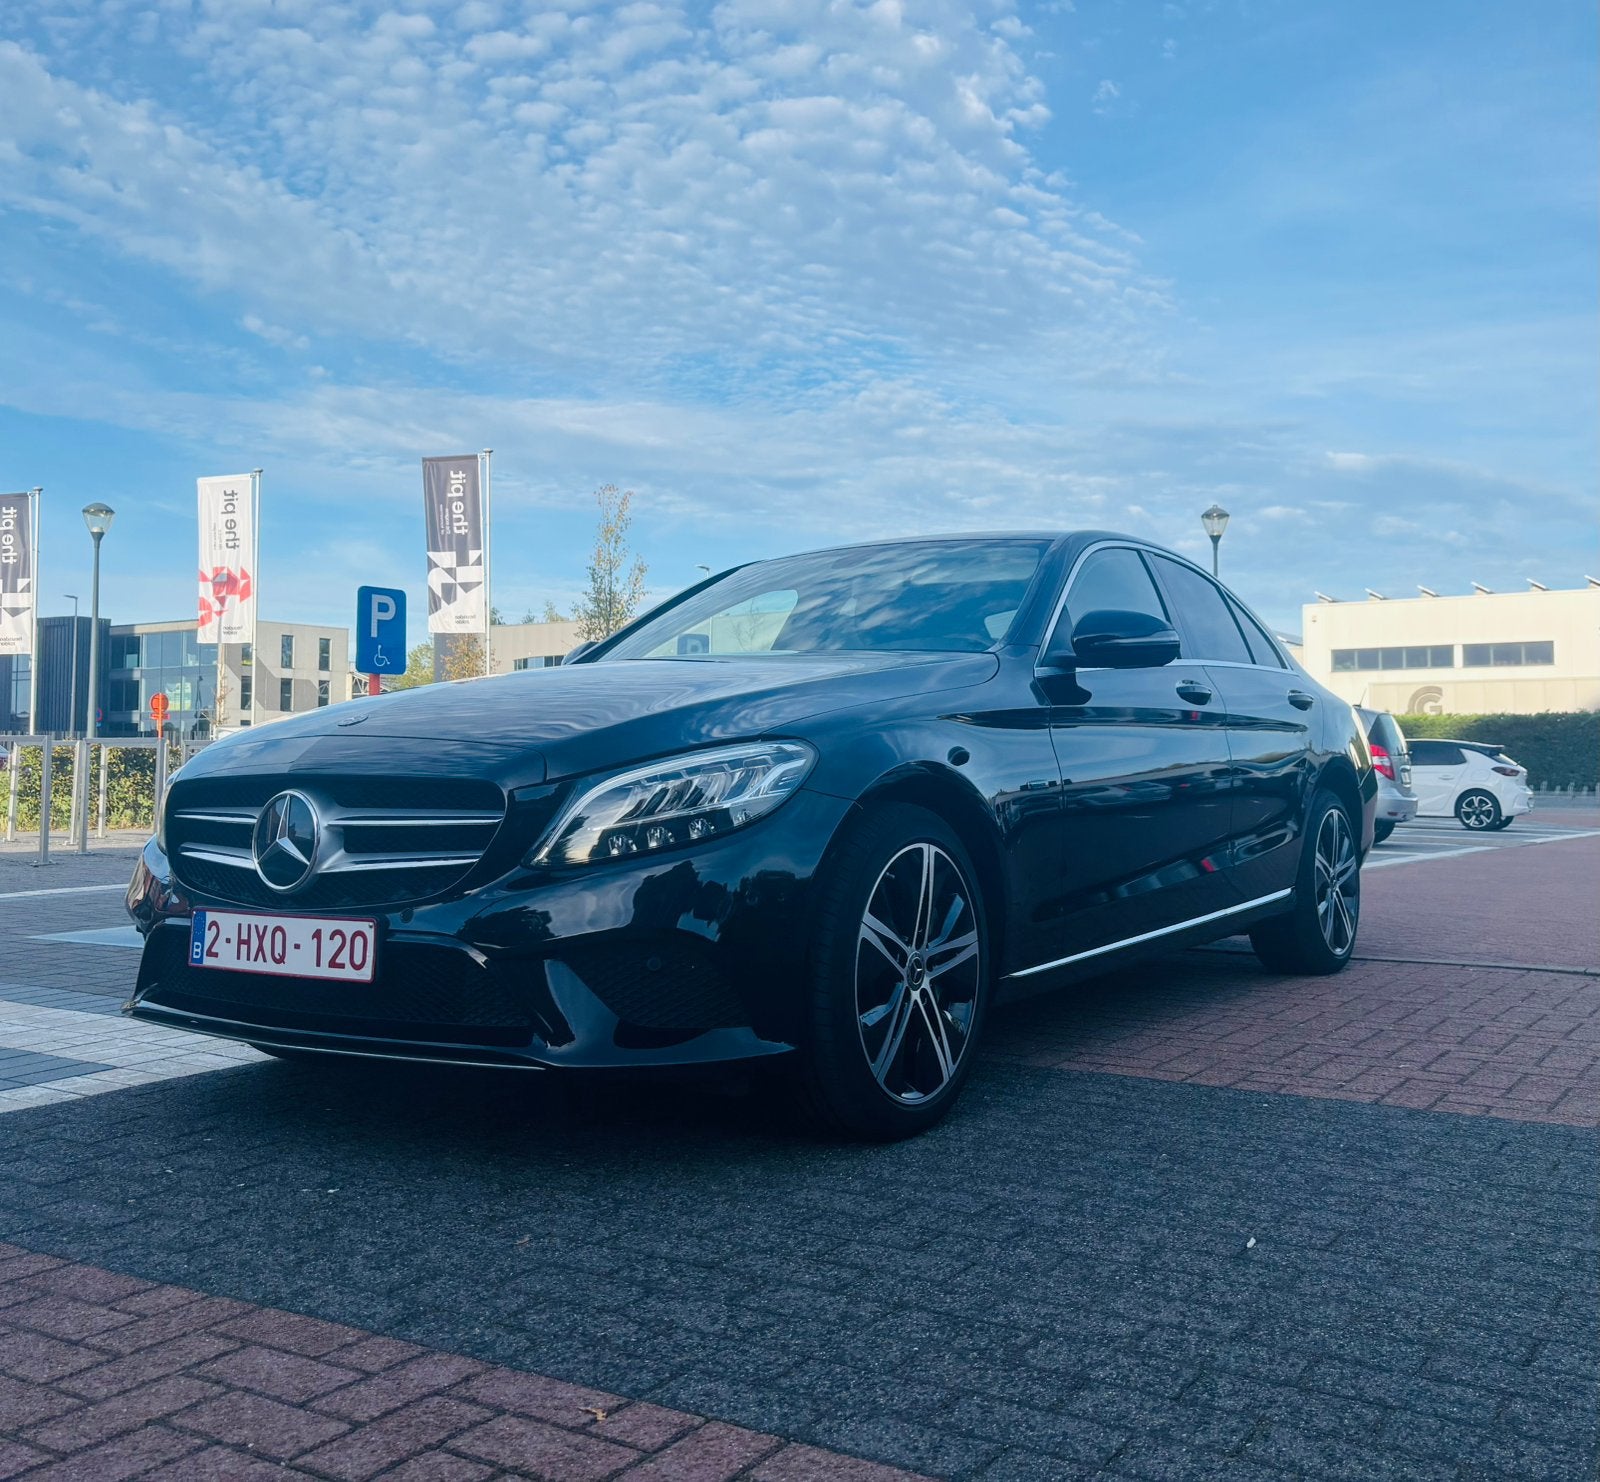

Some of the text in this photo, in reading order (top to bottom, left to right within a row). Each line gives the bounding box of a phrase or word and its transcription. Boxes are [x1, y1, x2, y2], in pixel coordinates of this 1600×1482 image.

[371, 594, 396, 638] P
[192, 941, 202, 959] B
[205, 919, 369, 971] 2-HXQ-120
